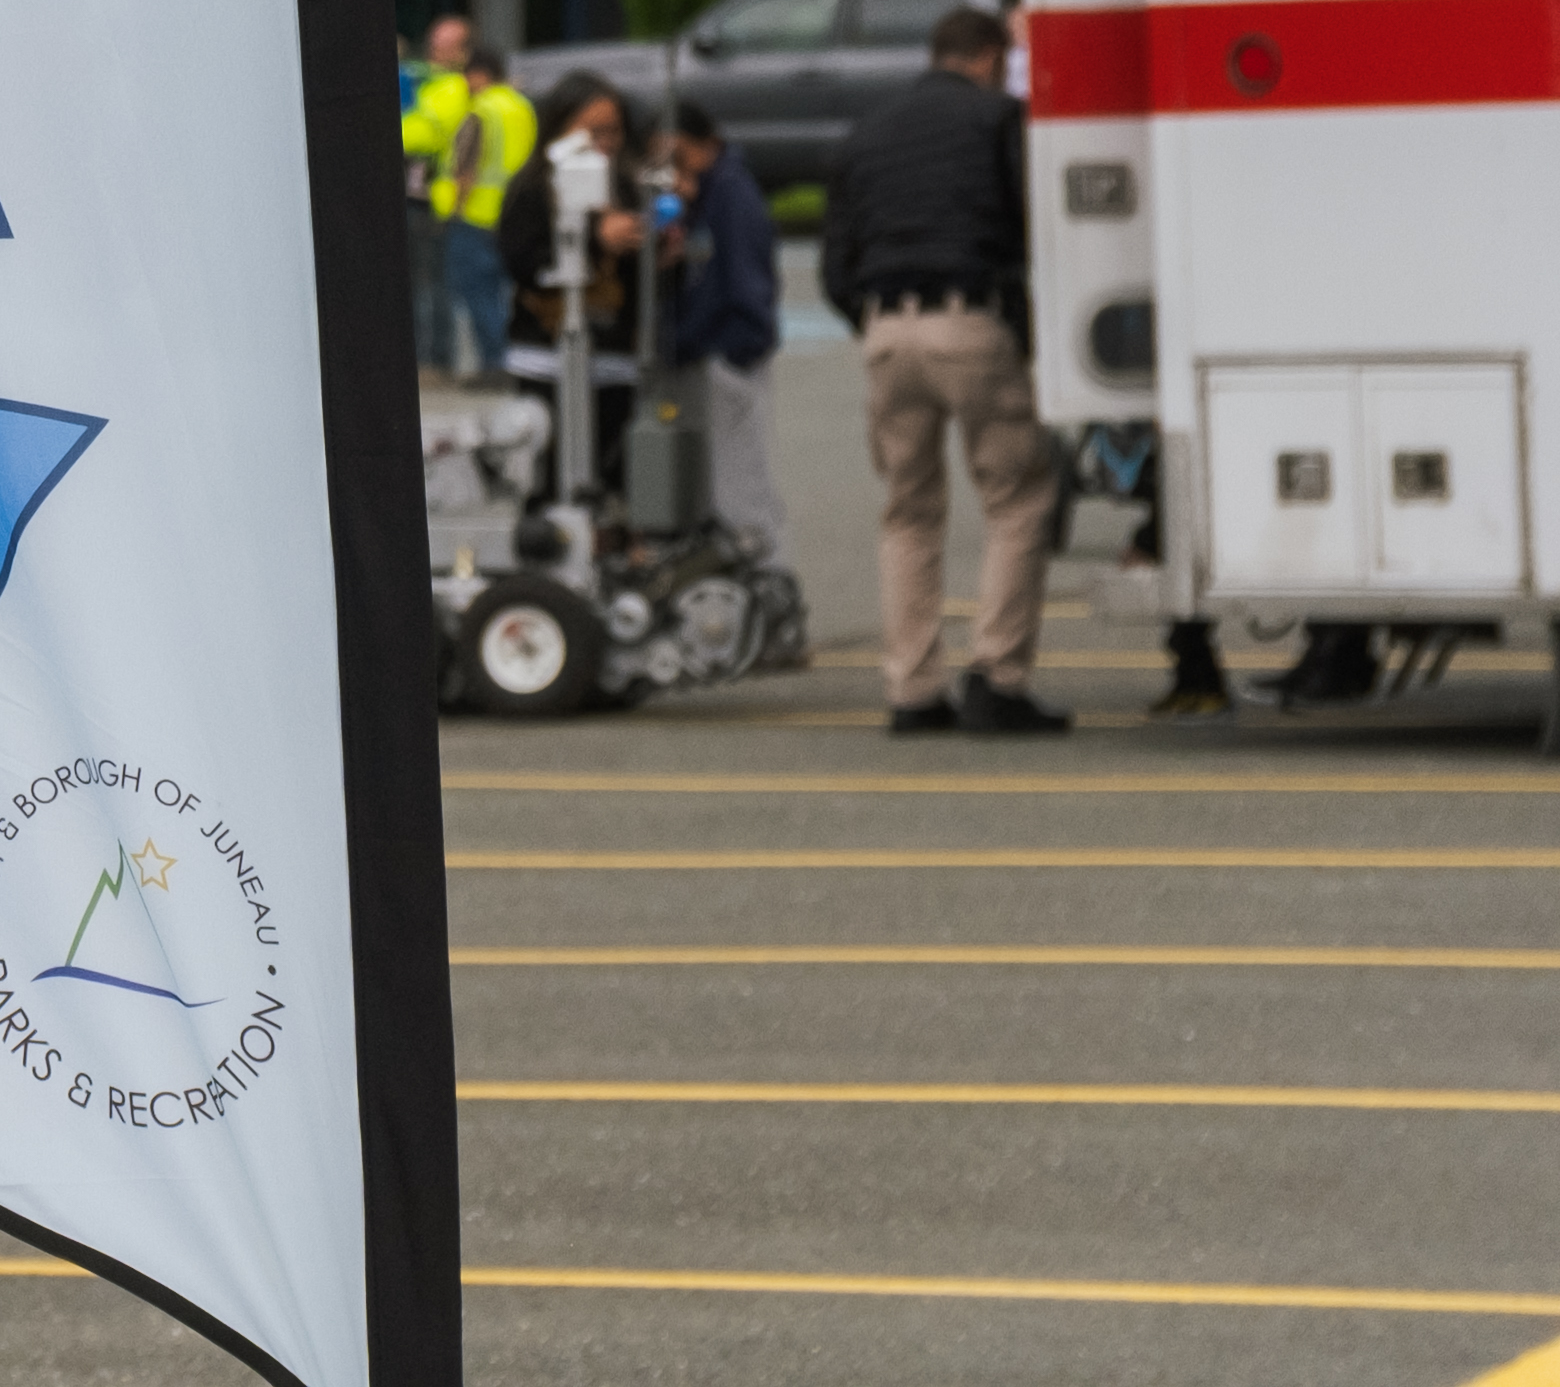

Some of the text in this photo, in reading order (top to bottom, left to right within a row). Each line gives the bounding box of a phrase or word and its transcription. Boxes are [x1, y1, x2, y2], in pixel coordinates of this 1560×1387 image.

[12, 756, 142, 820] BOROUGH
[153, 778, 202, 815] OF
[199, 819, 281, 946] JUNEAU
